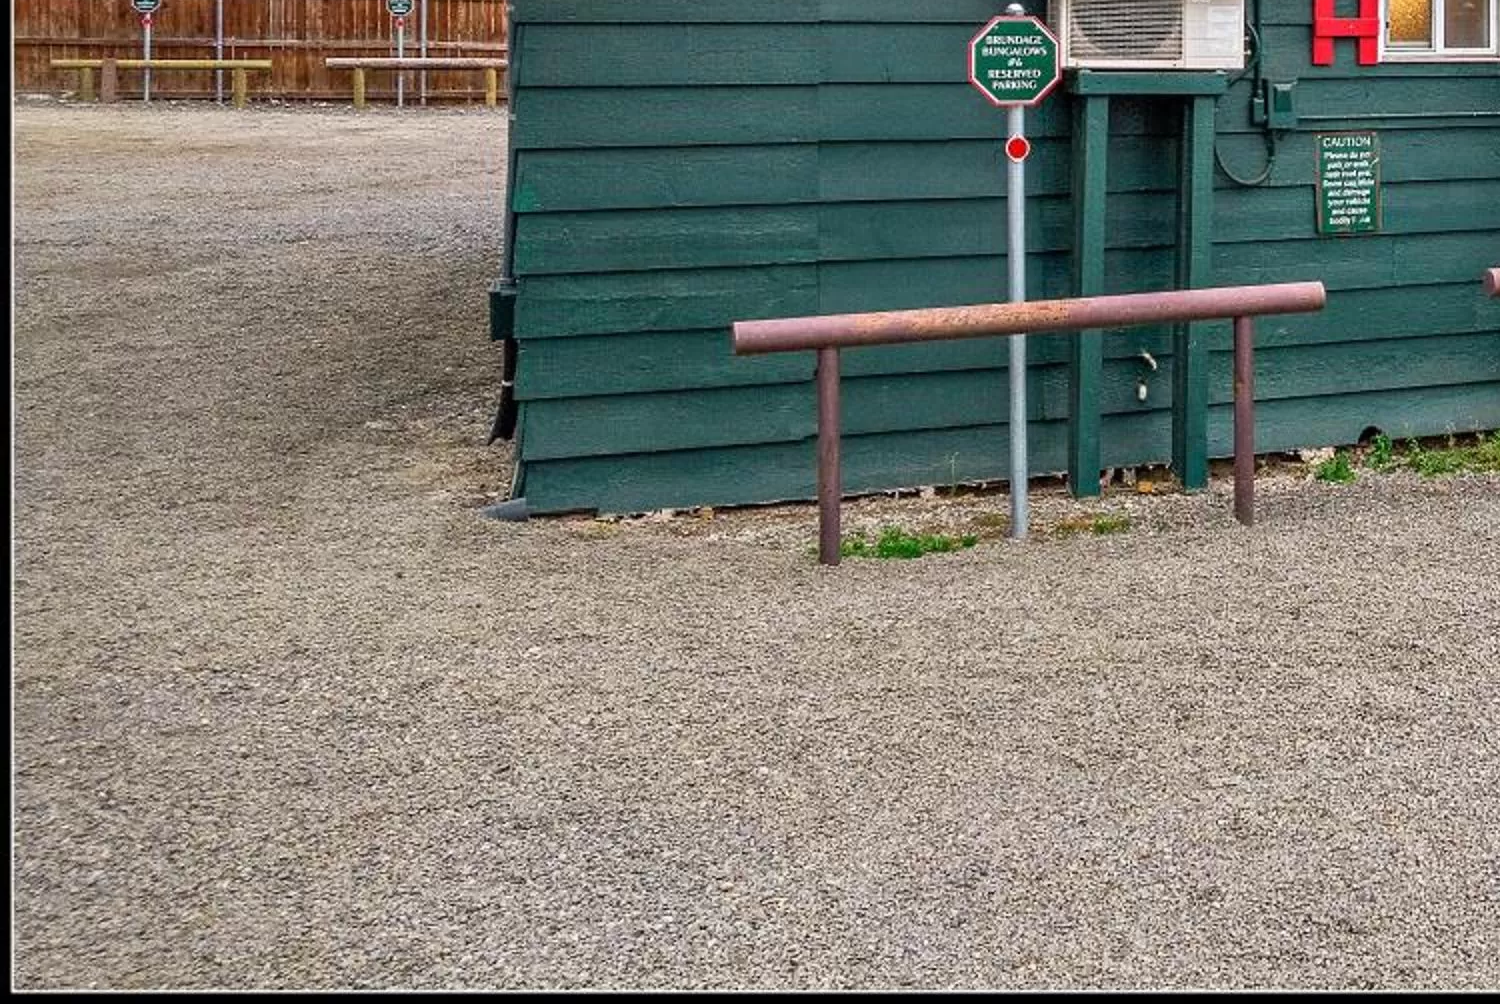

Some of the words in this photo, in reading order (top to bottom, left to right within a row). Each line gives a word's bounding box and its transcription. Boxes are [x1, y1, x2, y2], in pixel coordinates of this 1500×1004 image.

[985, 35, 1043, 45] BRUNDAGE
[981, 46, 1047, 56] BUNGALOWS
[1007, 57, 1023, 67] #6
[987, 69, 1042, 79] RESERVED
[992, 79, 1037, 90] PARKING
[1322, 136, 1371, 147] CAUTION
